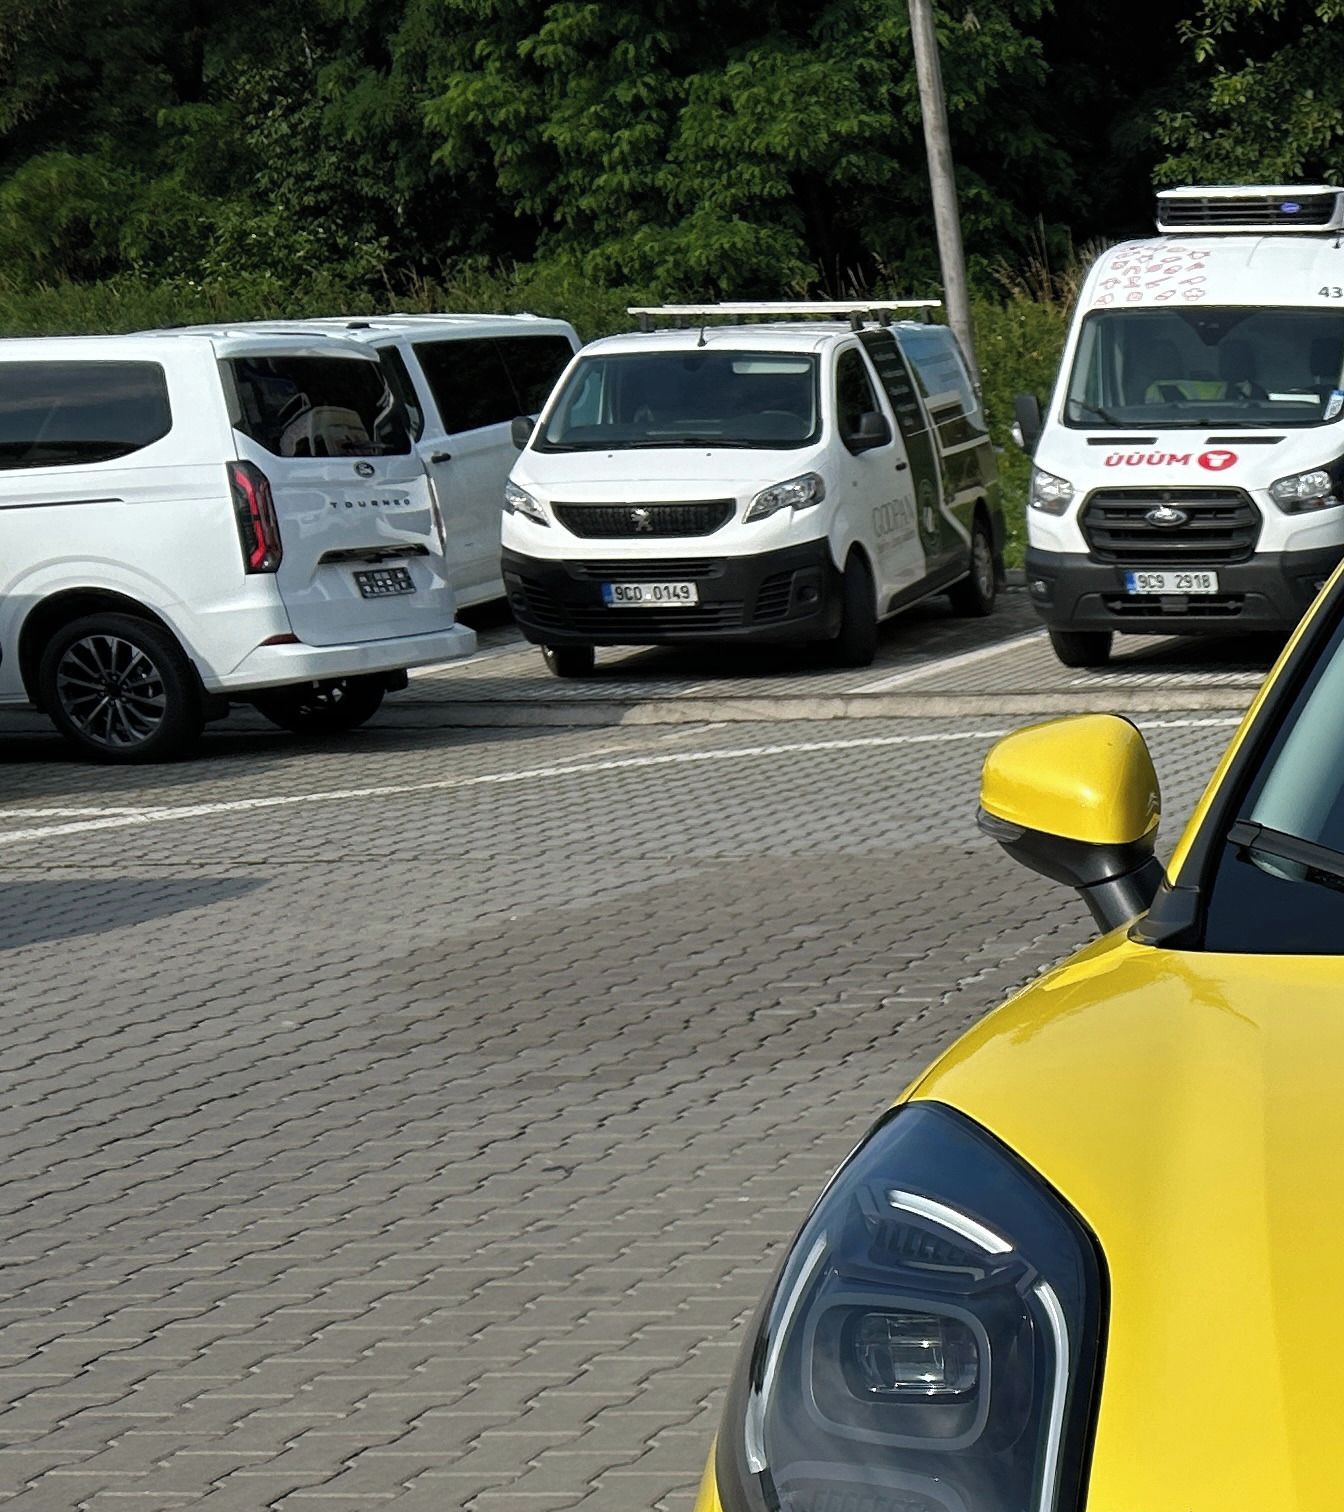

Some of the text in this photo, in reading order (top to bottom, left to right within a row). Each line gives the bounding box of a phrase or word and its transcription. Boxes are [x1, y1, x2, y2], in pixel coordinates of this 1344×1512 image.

[1318, 286, 1344, 299] 43
[330, 499, 410, 509] TOURNEO
[1174, 574, 1210, 589] 2918
[653, 585, 690, 601] 0149
